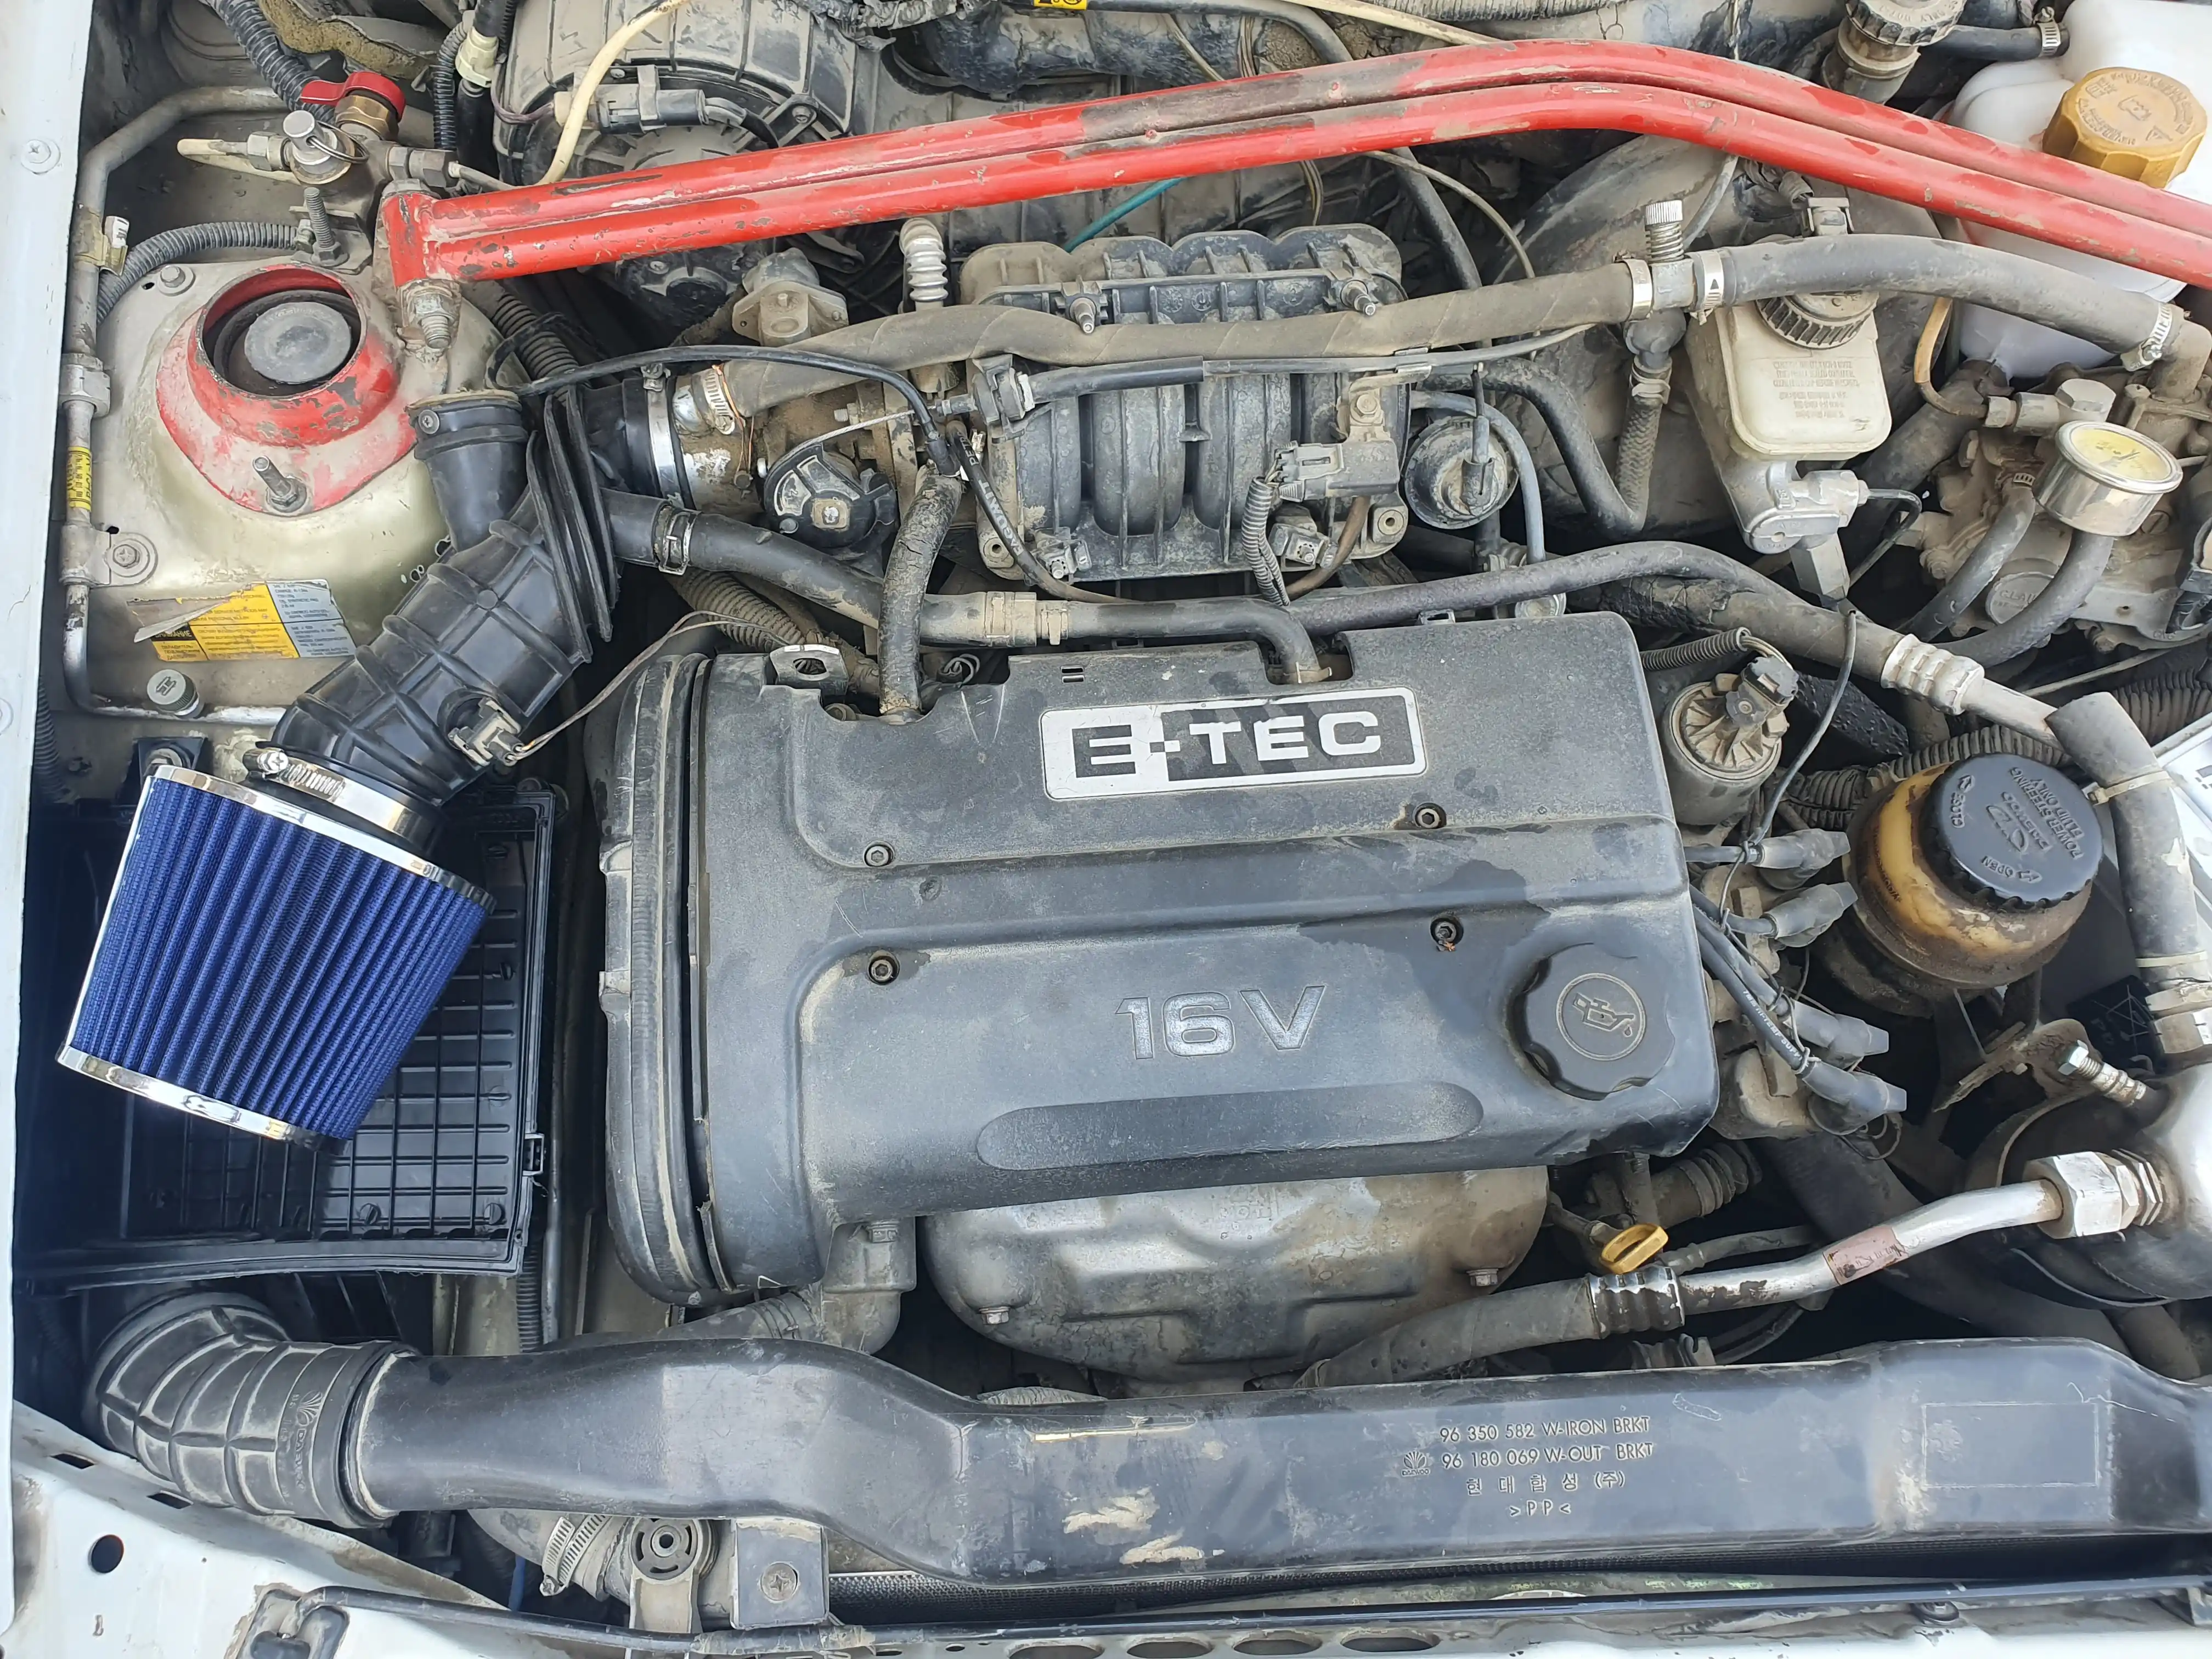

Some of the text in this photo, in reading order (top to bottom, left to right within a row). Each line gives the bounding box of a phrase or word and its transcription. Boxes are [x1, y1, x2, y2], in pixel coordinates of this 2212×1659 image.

[978, 479, 1024, 556] FAGUMIT
[1950, 792, 1966, 829] CLOSE
[2001, 791, 2053, 852] DAEWOO
[2008, 766, 2085, 860] POWER STEERING
[2029, 778, 2085, 840] FLUID ONLY
[1981, 855, 2016, 878] OPEN
[1440, 1415, 1650, 1443] 96 350 582 W-IRON BRKT
[1401, 1468, 1431, 1477] DAEWOO
[1442, 1442, 1654, 1470] 96 180 069 W-OUT BRKT
